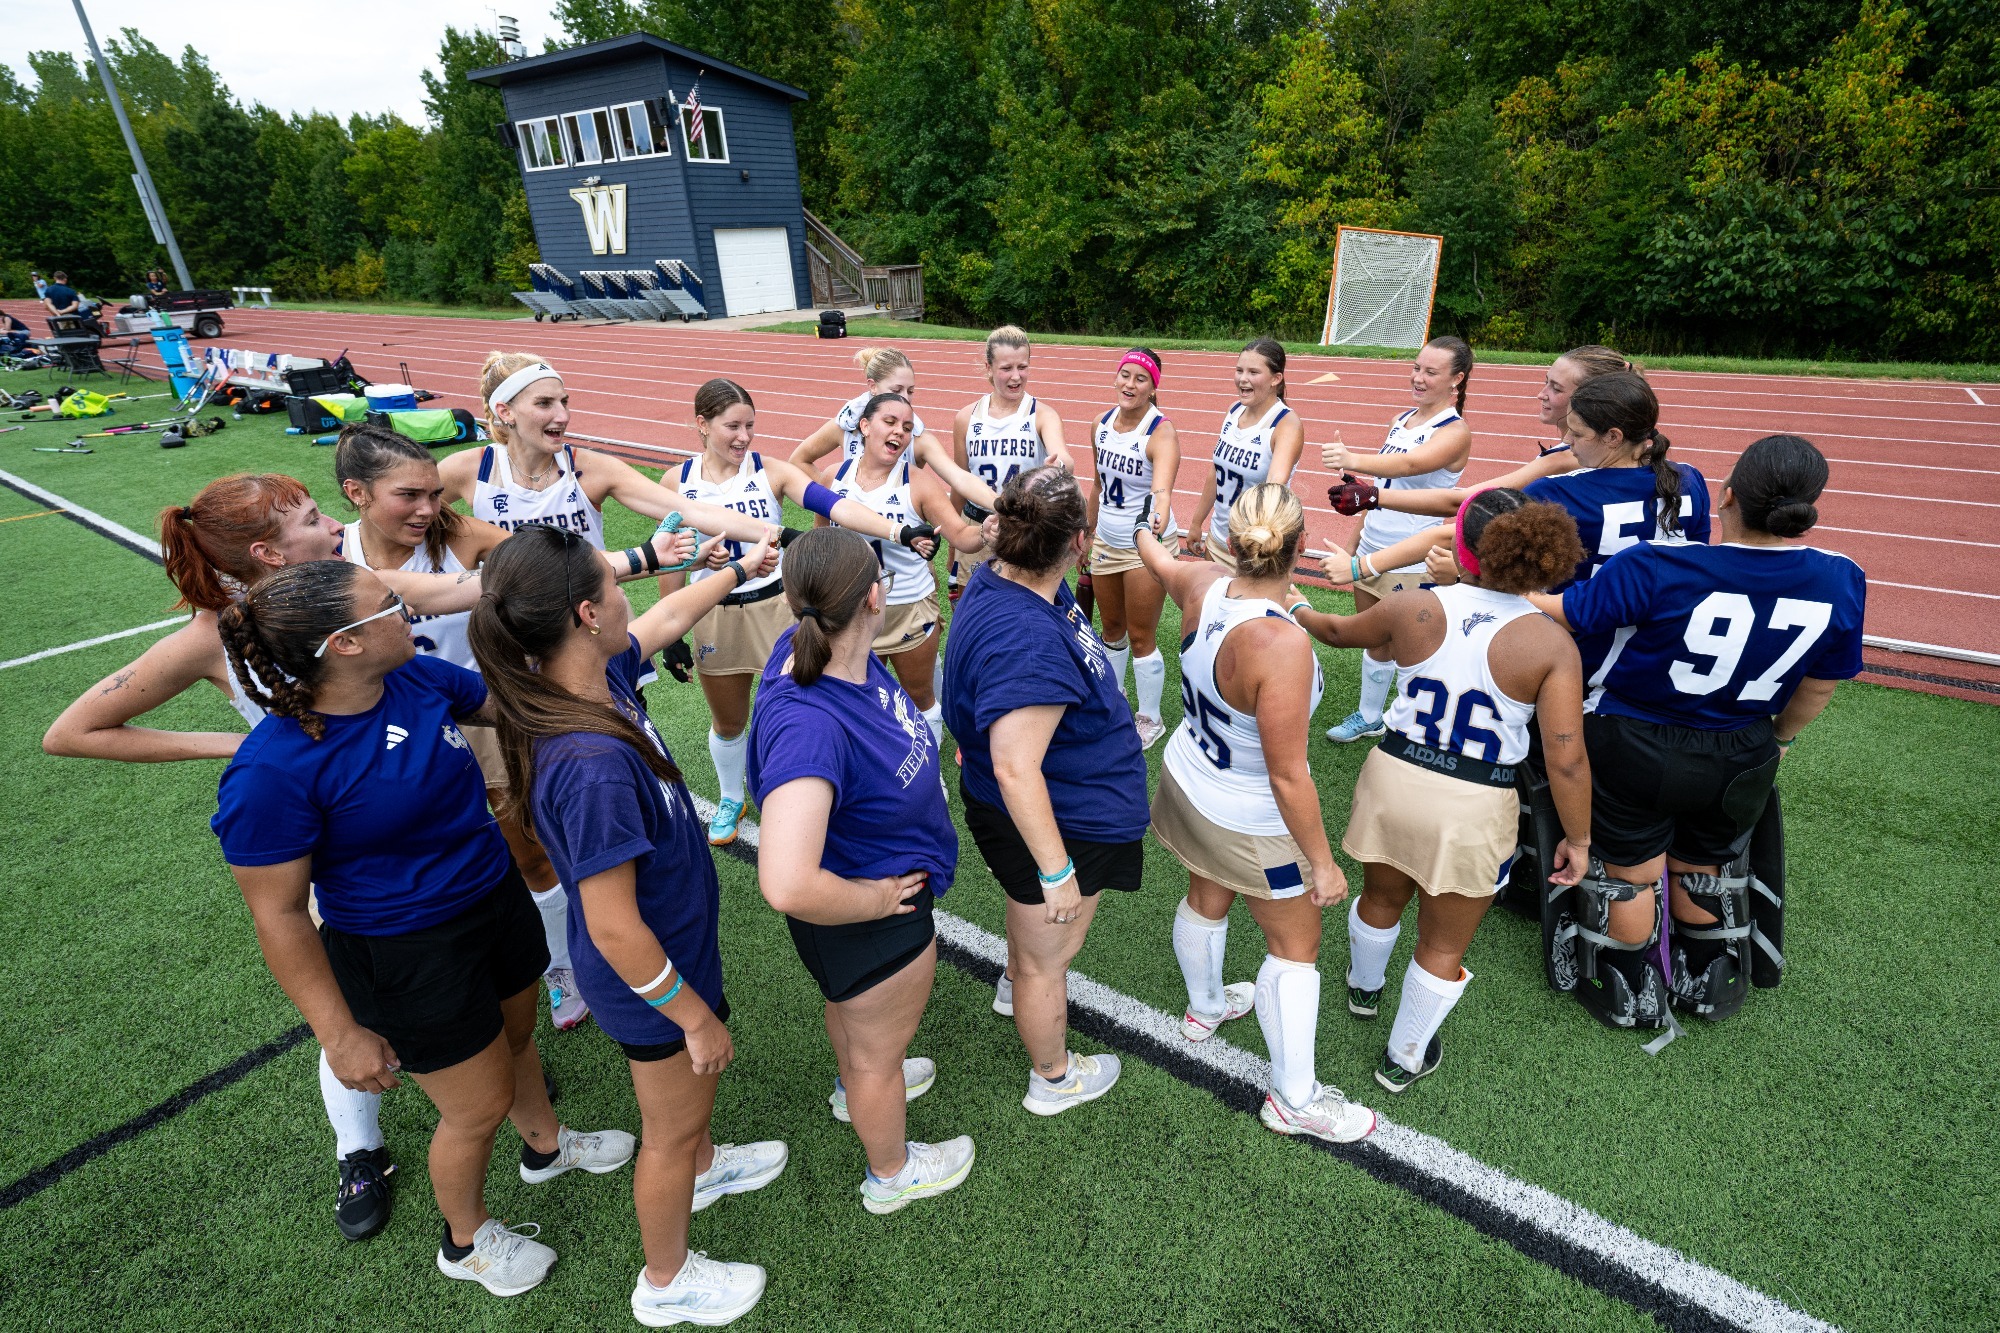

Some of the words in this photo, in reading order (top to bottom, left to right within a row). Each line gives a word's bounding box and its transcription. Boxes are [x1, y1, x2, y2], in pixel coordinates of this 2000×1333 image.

[569, 184, 627, 255] W
[321, 419, 337, 428] UP
[969, 438, 1035, 458] CONVERSE
[1100, 472, 1126, 510] 14
[1214, 463, 1244, 507] 27
[1668, 591, 1833, 701] 97
[1395, 674, 1504, 765] 36
[899, 740, 925, 785] FIELD
[463, 1255, 491, 1275] N
